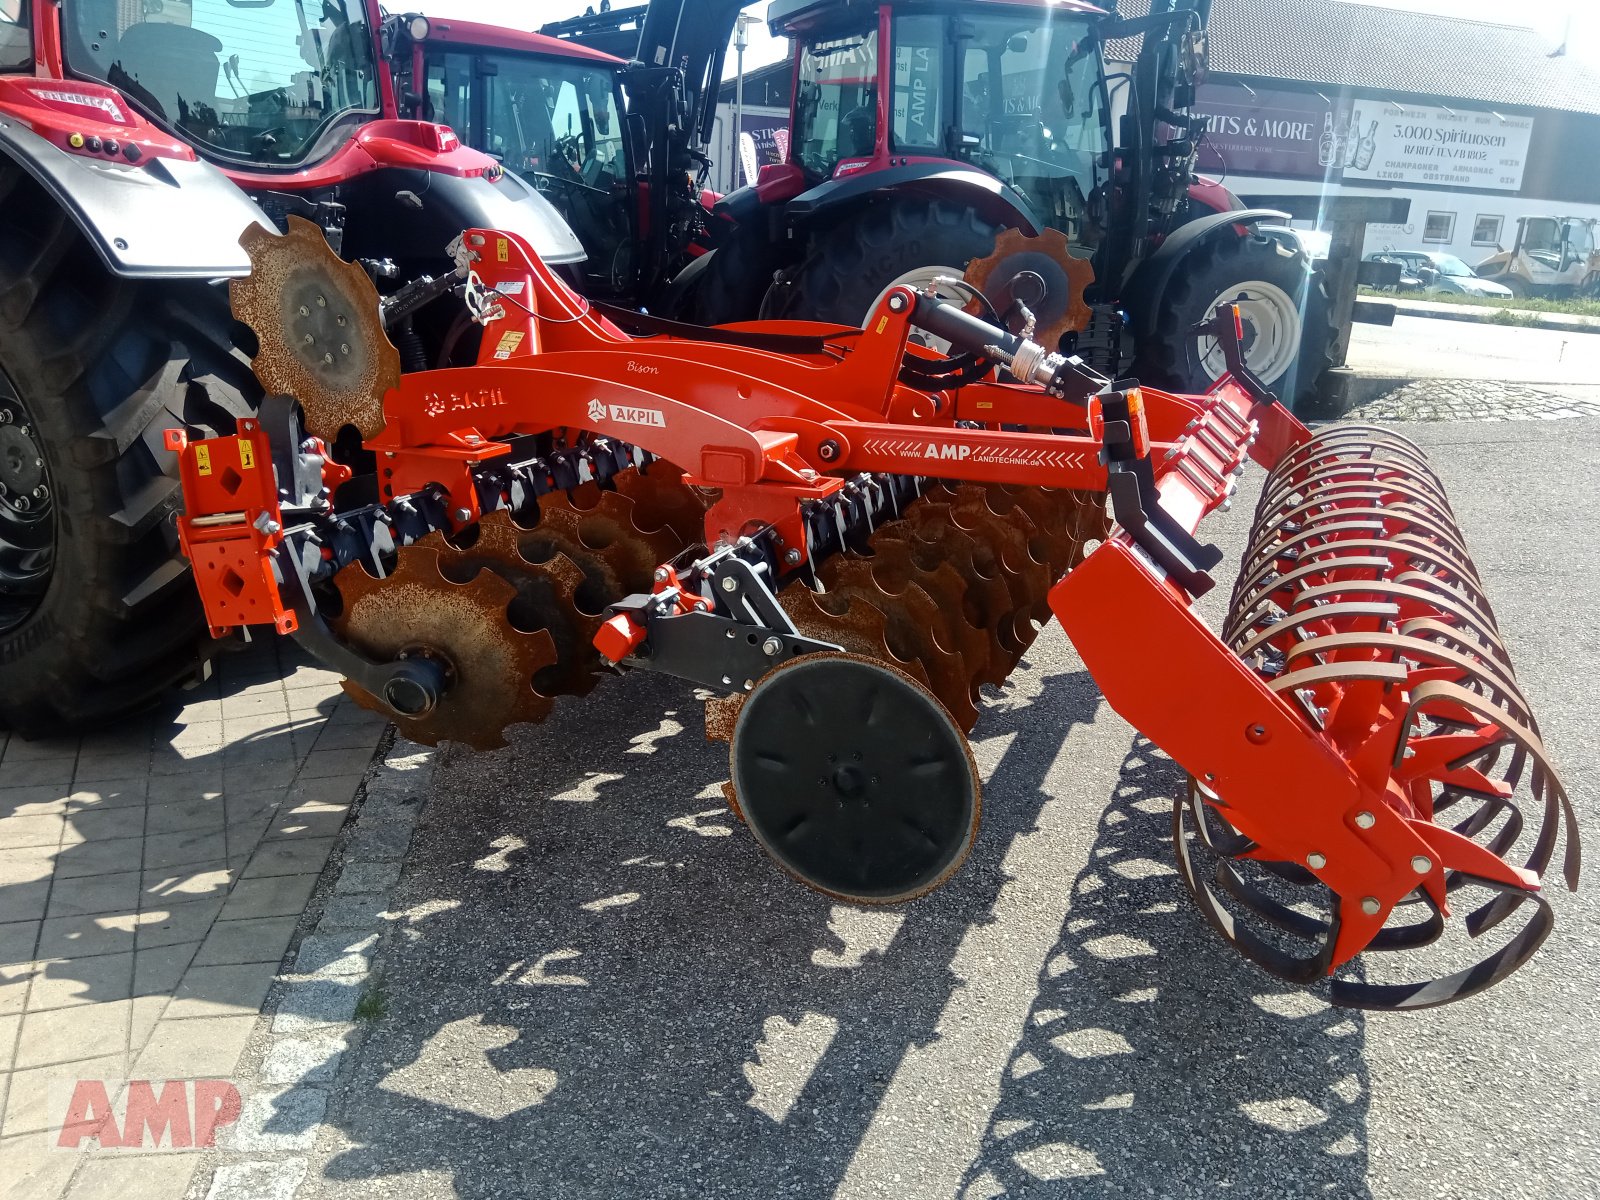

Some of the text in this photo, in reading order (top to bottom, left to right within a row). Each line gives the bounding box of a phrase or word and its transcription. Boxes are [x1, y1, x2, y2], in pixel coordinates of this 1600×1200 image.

[1244, 117, 1258, 137] &
[1261, 119, 1314, 141] MORE
[1394, 125, 1506, 148] 3.000 Spirituosen
[1385, 160, 1439, 171] CHAMPAGNER
[1423, 172, 1470, 183] OBSTBRAND
[627, 360, 659, 375] Bison
[615, 409, 659, 425] AKPIL
